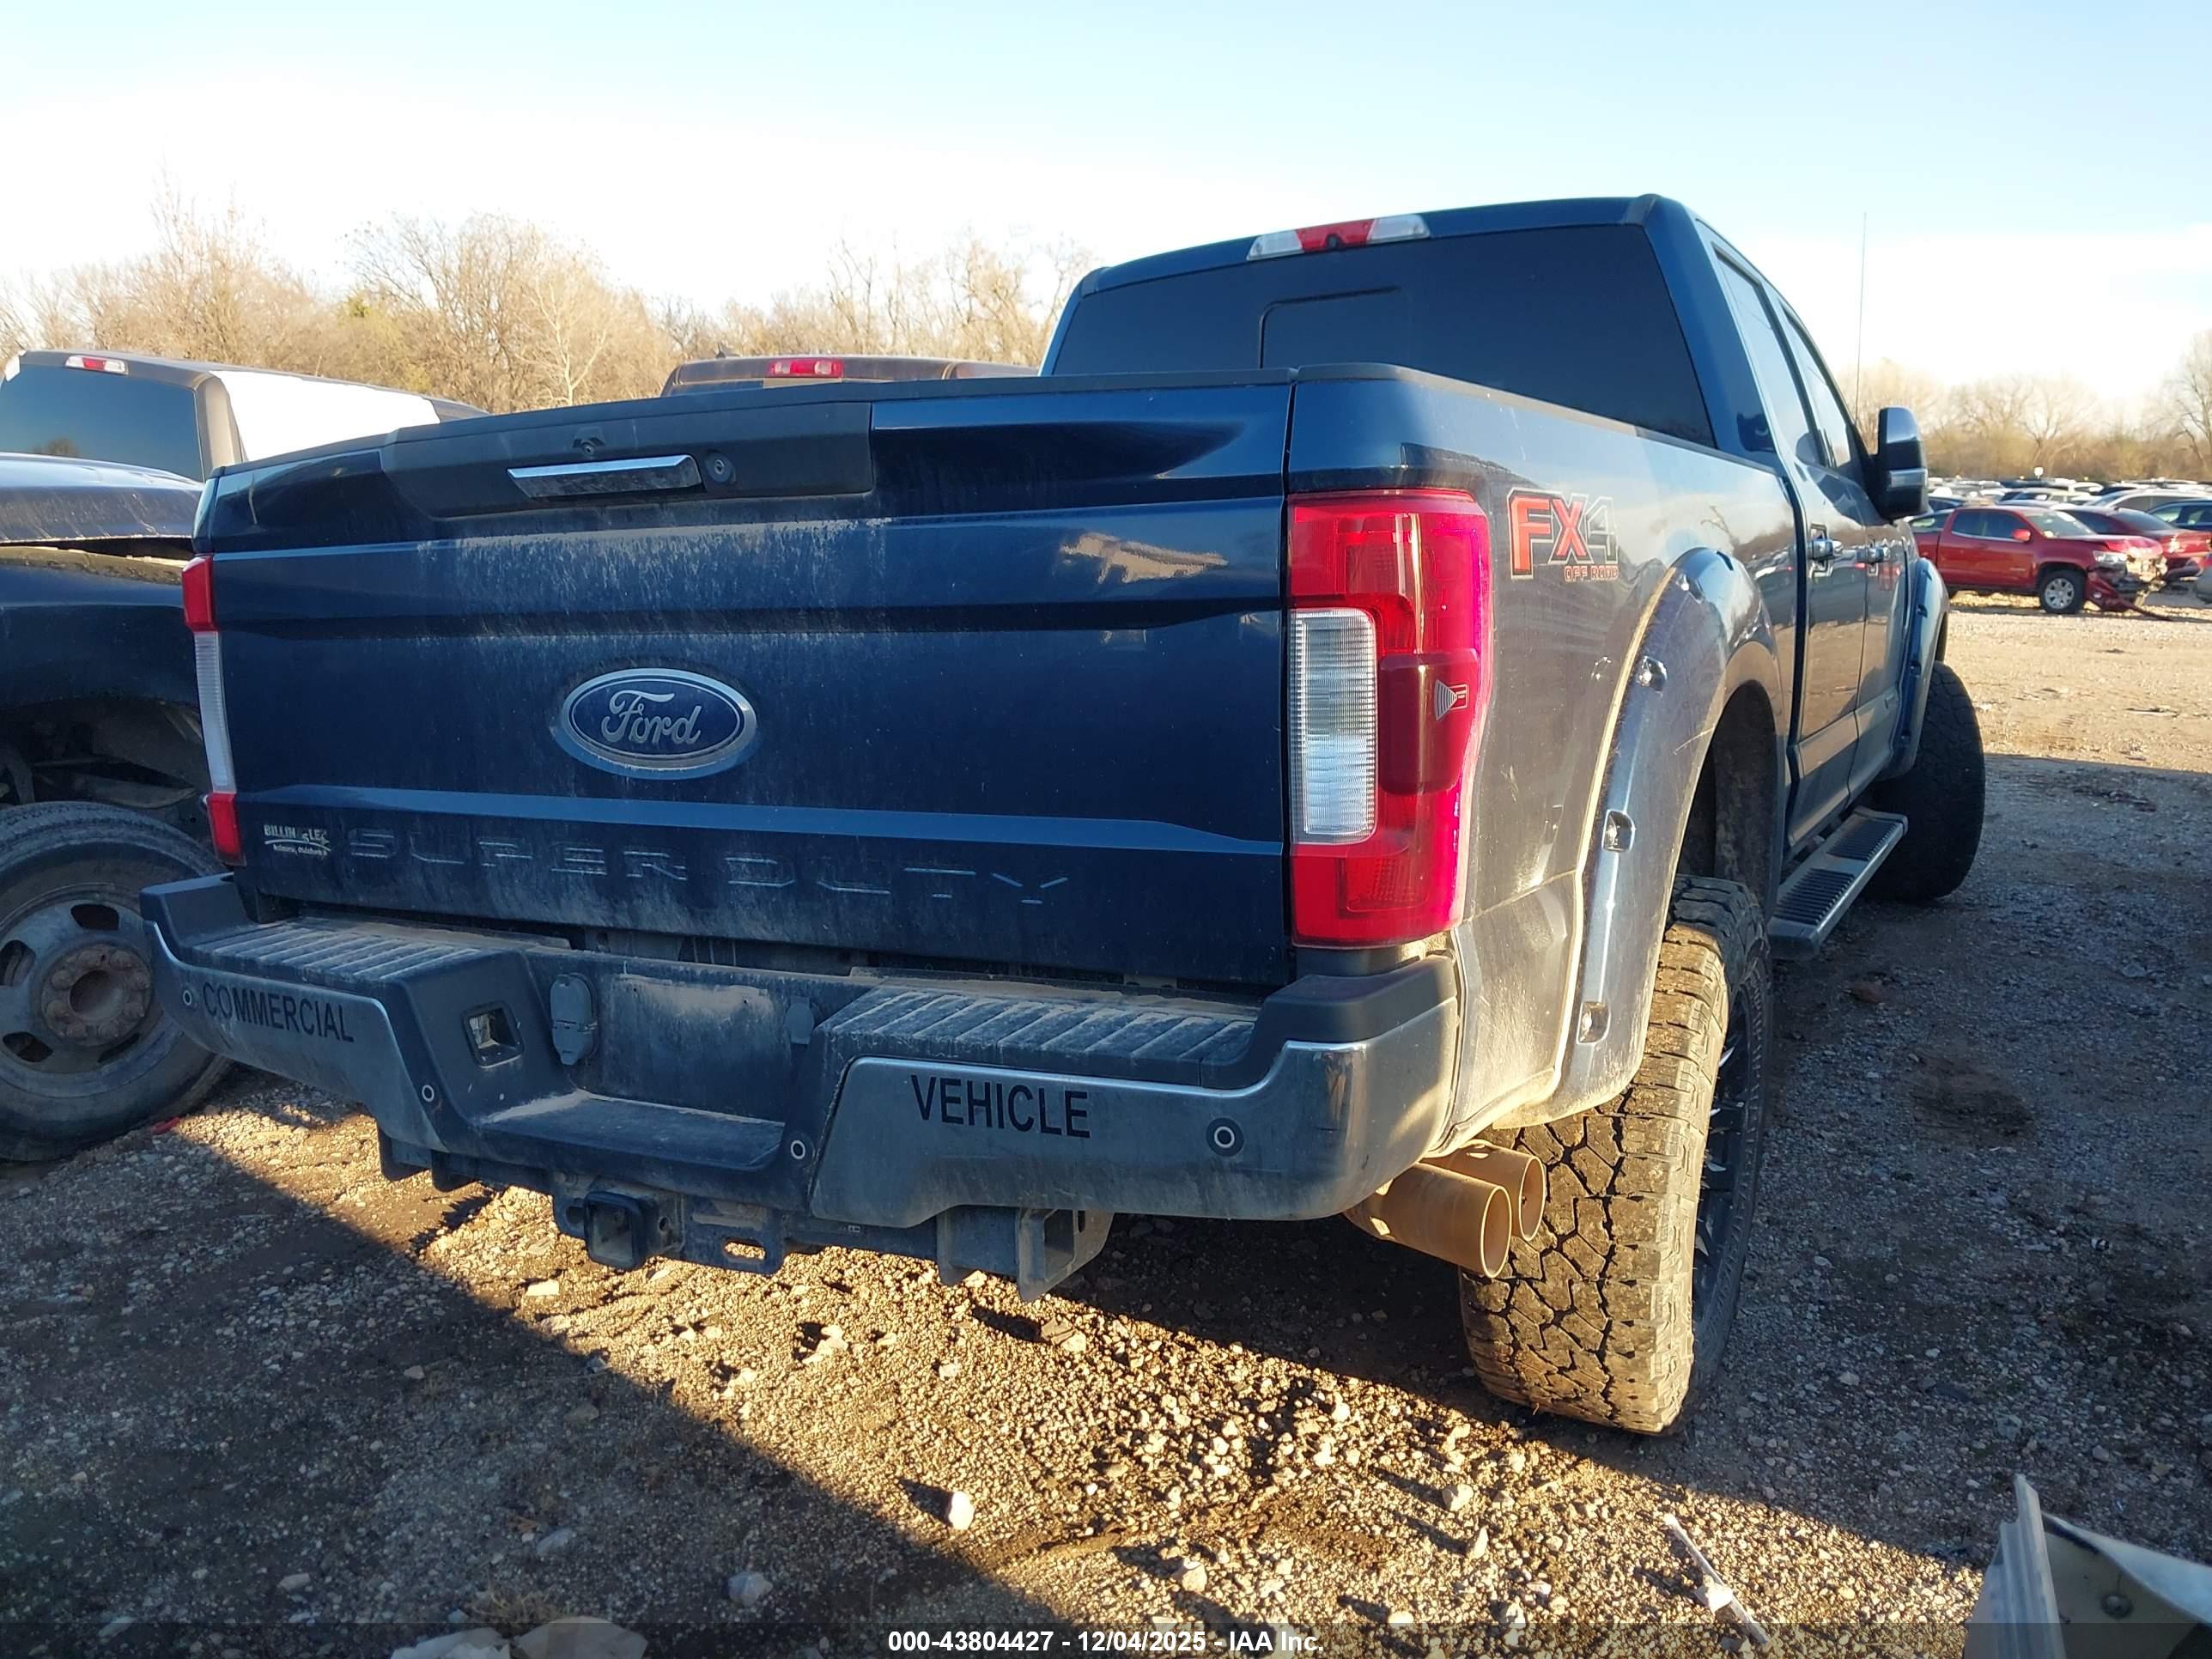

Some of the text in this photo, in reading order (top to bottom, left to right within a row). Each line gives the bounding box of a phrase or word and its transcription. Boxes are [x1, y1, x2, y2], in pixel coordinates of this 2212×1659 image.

[1507, 487, 1619, 580] FX4
[1565, 565, 1620, 582] OFF ROAD
[601, 690, 702, 744] Ford
[348, 829, 1070, 904] SUPER DUTY
[203, 981, 1091, 1139] COMMERCIAL VEHICLE
